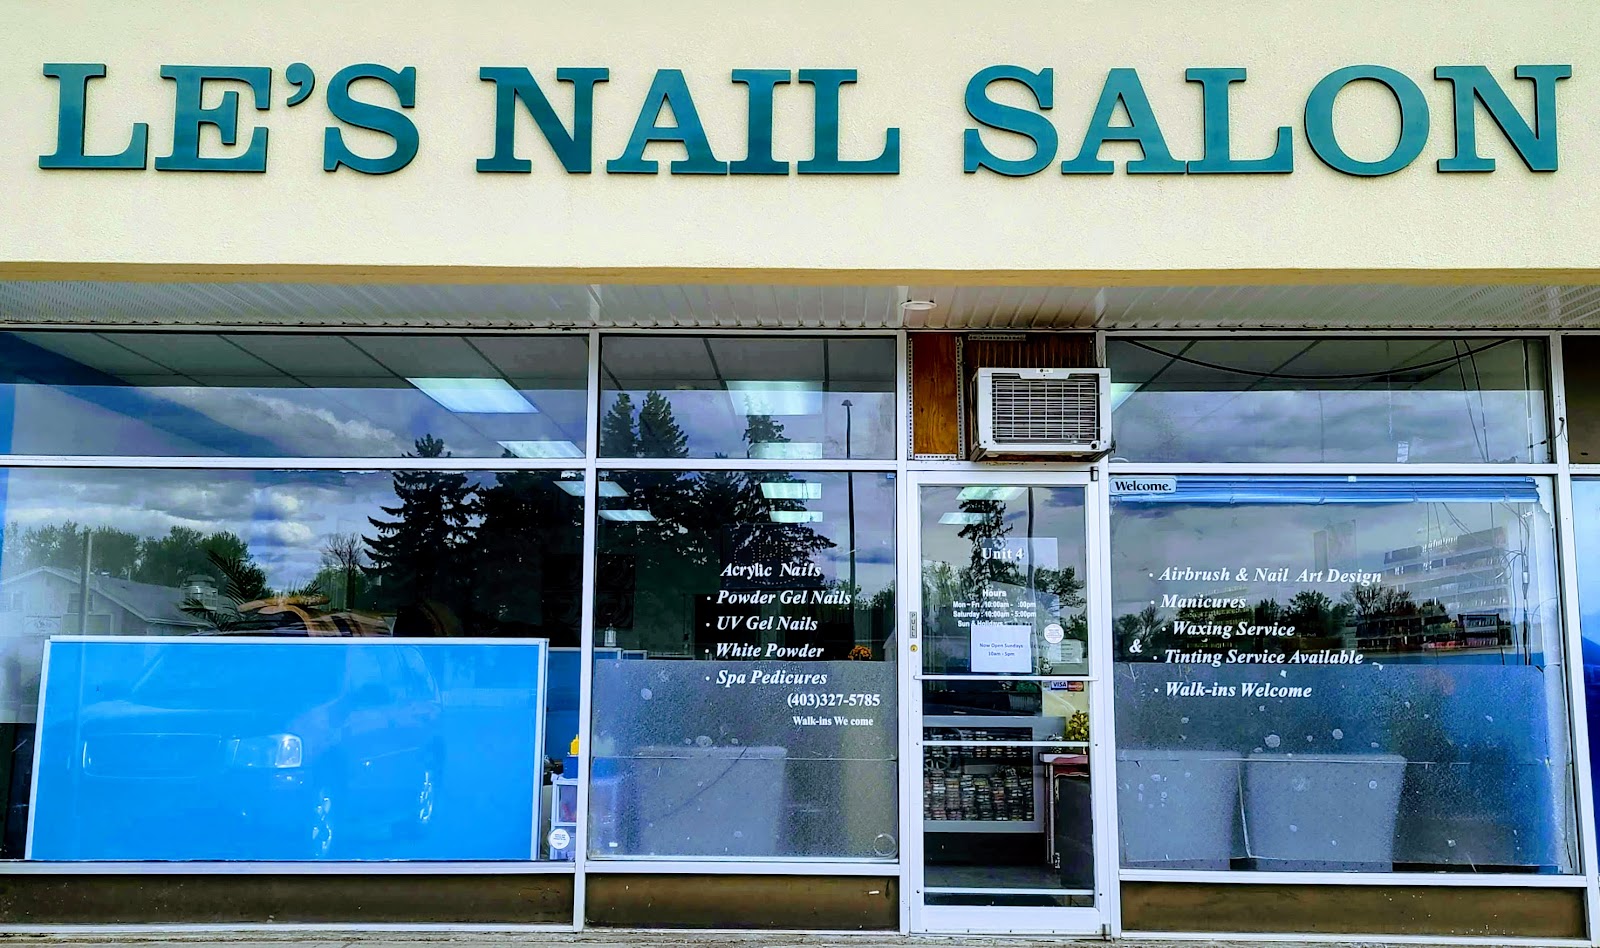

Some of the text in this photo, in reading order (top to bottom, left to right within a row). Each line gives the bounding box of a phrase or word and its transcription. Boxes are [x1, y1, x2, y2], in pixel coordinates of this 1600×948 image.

[38, 62, 1572, 177] LE'S NAIL SALON
[982, 547, 1024, 560] Unit 4
[720, 563, 822, 580] Acrylic Nails
[1158, 567, 1381, 586] Airbrush & Nail Art Design
[716, 590, 852, 605] Powder Gel Nails
[982, 589, 1007, 598] Hours
[1161, 594, 1246, 609] Manicures
[953, 611, 980, 619] Saturday
[717, 616, 818, 631] UV Gel Nails
[1173, 621, 1295, 638] Waxing Service
[716, 643, 824, 658] White Powder
[1129, 639, 1364, 667] & Tinting Service Available
[716, 670, 828, 687] Spa Pedicures
[1165, 681, 1313, 698] Walk-ins Welcome
[787, 693, 881, 709] (403)327-5785
[792, 716, 832, 726] Walk-ins
